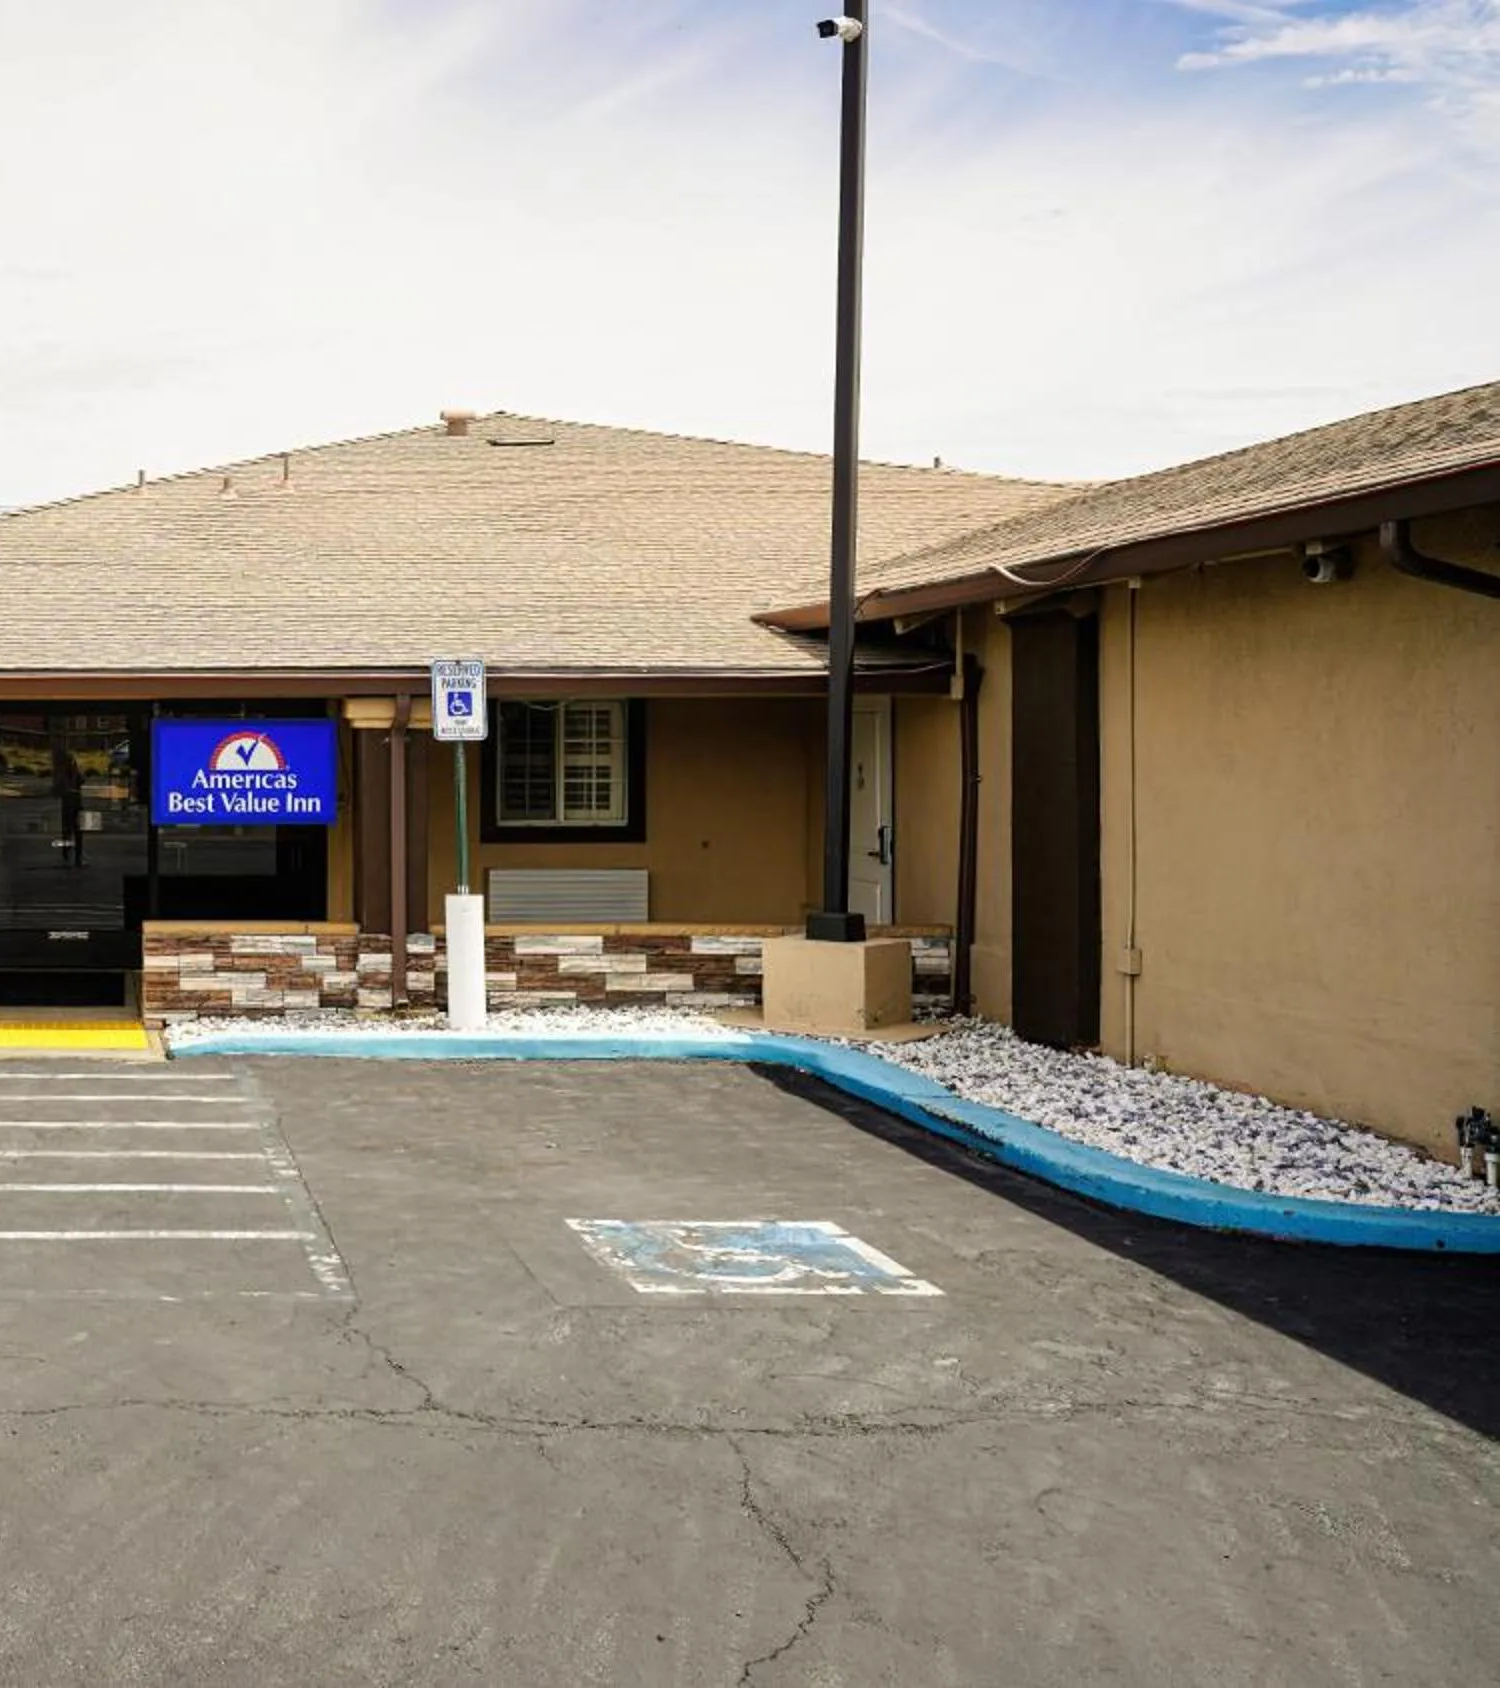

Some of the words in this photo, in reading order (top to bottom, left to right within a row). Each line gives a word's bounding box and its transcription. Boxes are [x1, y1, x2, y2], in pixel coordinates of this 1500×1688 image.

[437, 663, 480, 676] RESERVED
[441, 677, 477, 688] PARKING
[191, 768, 297, 789] Americas
[168, 792, 214, 813] Best
[221, 791, 279, 813] Value
[285, 792, 321, 813] Inn
